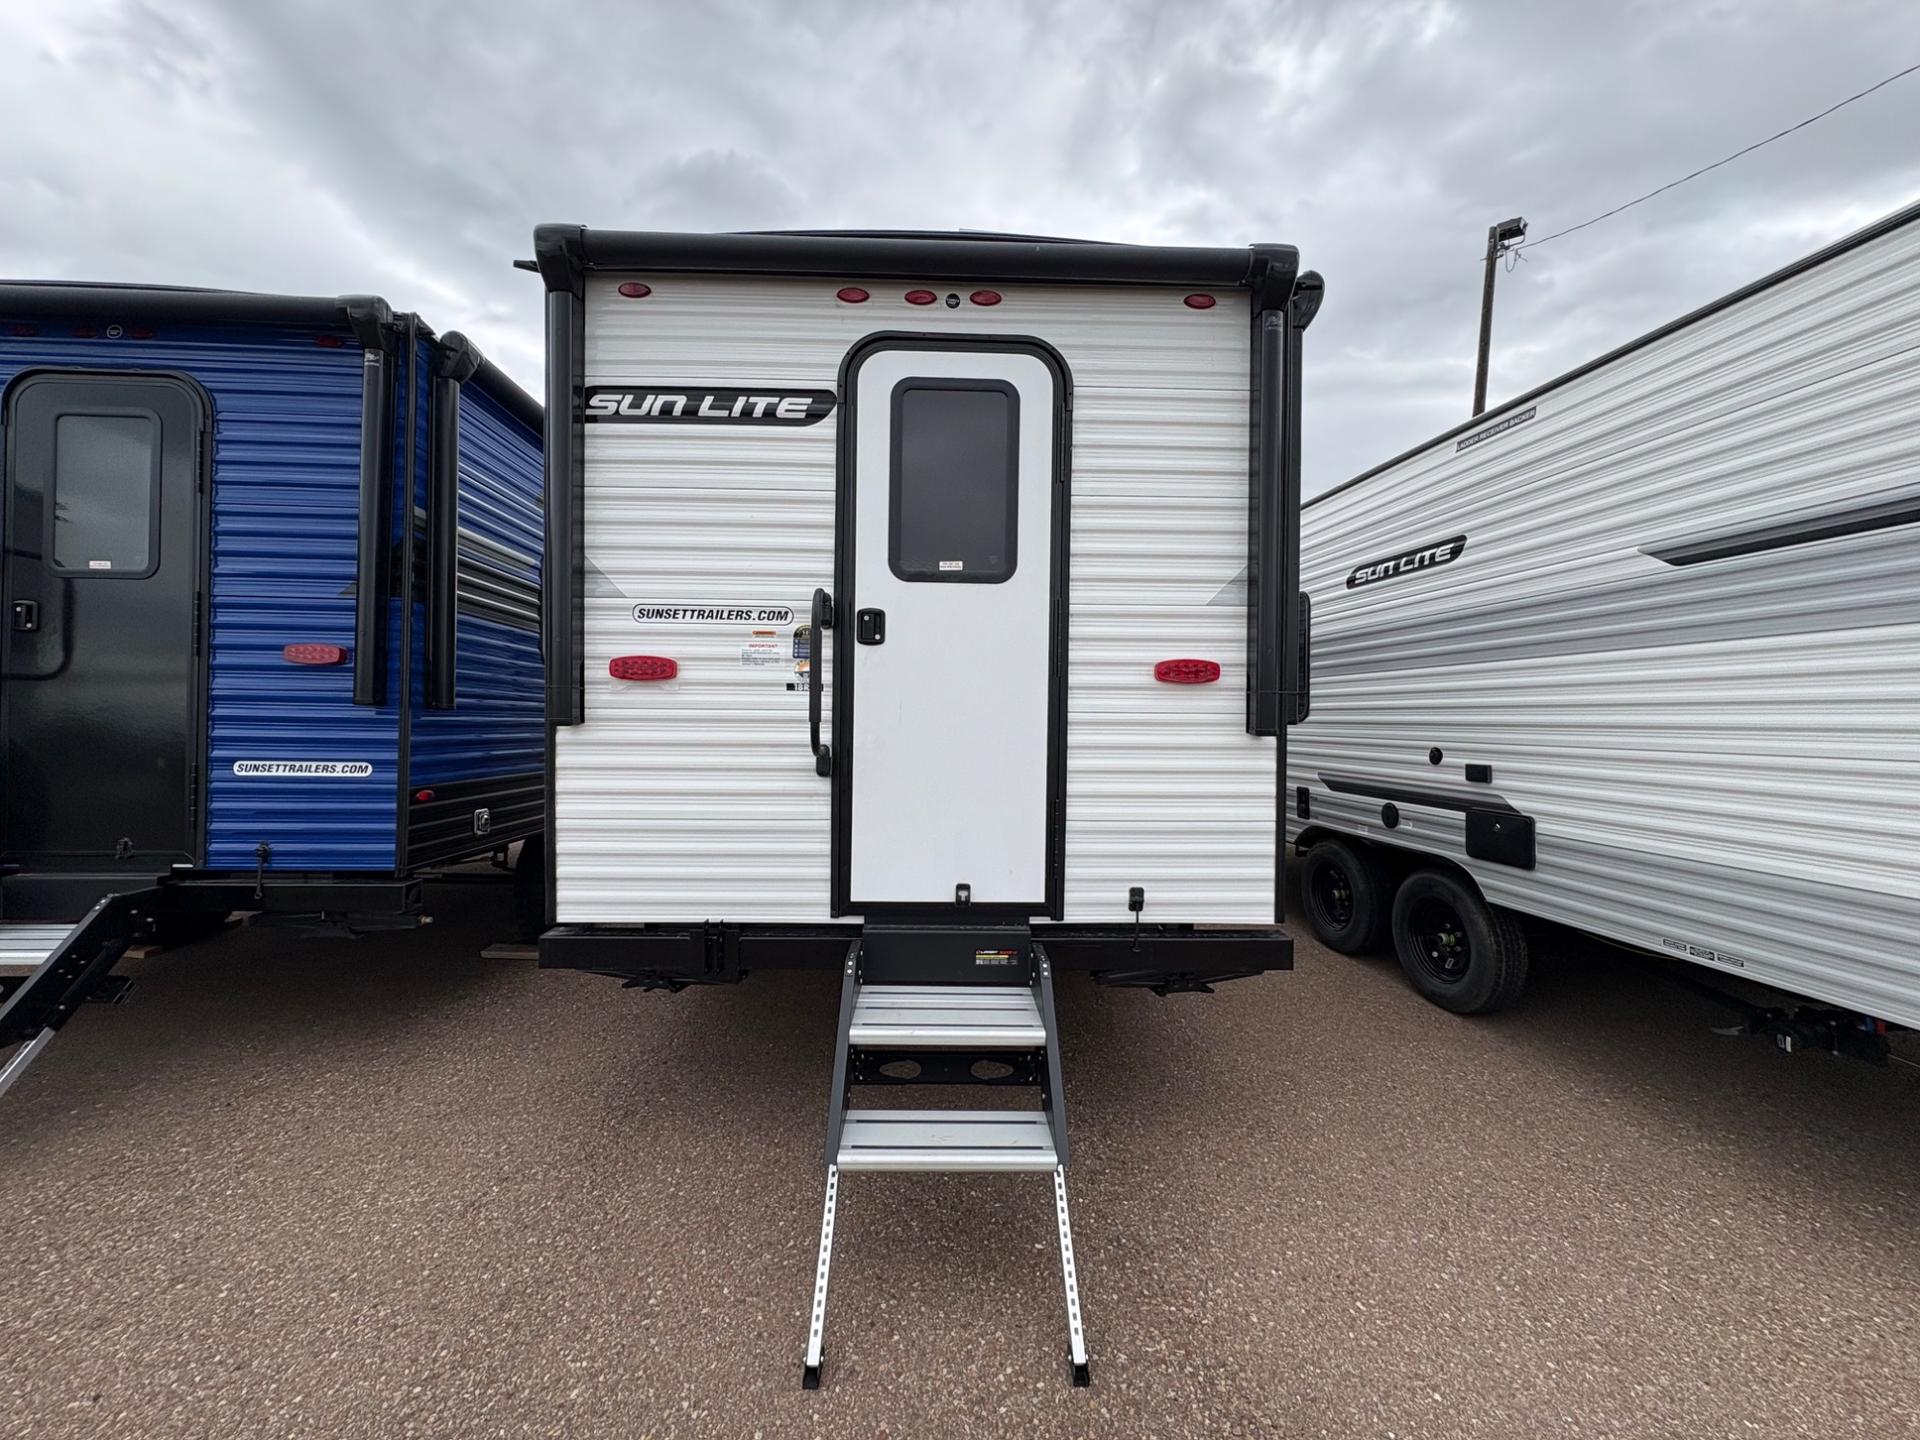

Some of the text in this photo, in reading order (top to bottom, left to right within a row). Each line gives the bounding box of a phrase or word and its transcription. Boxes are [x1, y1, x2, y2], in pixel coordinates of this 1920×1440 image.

[585, 394, 813, 418] SUN LITE
[1354, 543, 1455, 584] SUN LITE
[637, 608, 790, 621] SUNSETTRAILERS.COM
[236, 763, 369, 774] SUNSETTRAILERS.COM
